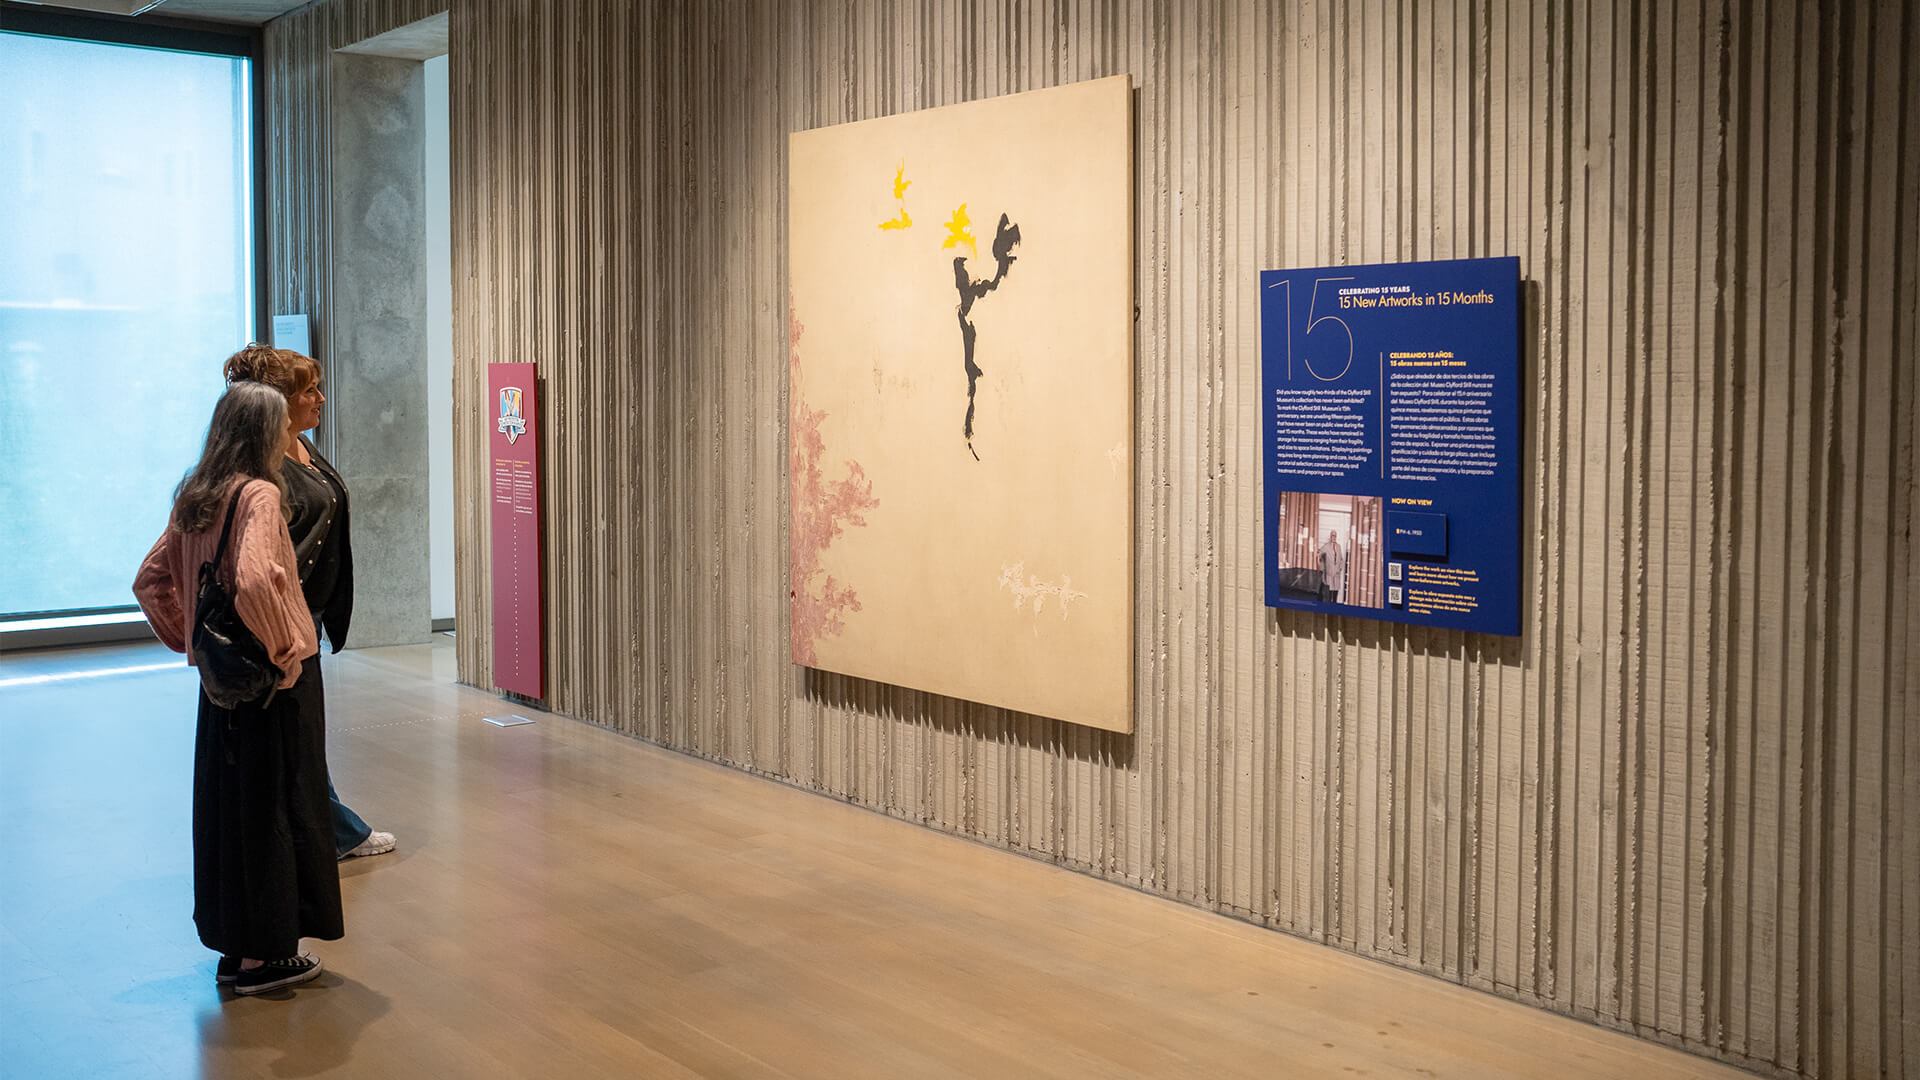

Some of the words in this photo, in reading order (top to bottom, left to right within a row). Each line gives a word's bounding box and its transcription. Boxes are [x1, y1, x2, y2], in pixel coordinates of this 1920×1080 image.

[1339, 288, 1380, 296] CELEBRATING
[1390, 286, 1411, 294] YEARS
[1339, 297, 1351, 309] 15
[1353, 296, 1377, 308] New
[1379, 293, 1424, 307] Artworks
[1426, 293, 1435, 306] in
[1438, 292, 1450, 305] 15
[1453, 289, 1495, 305] Months
[1269, 277, 1355, 381] 15
